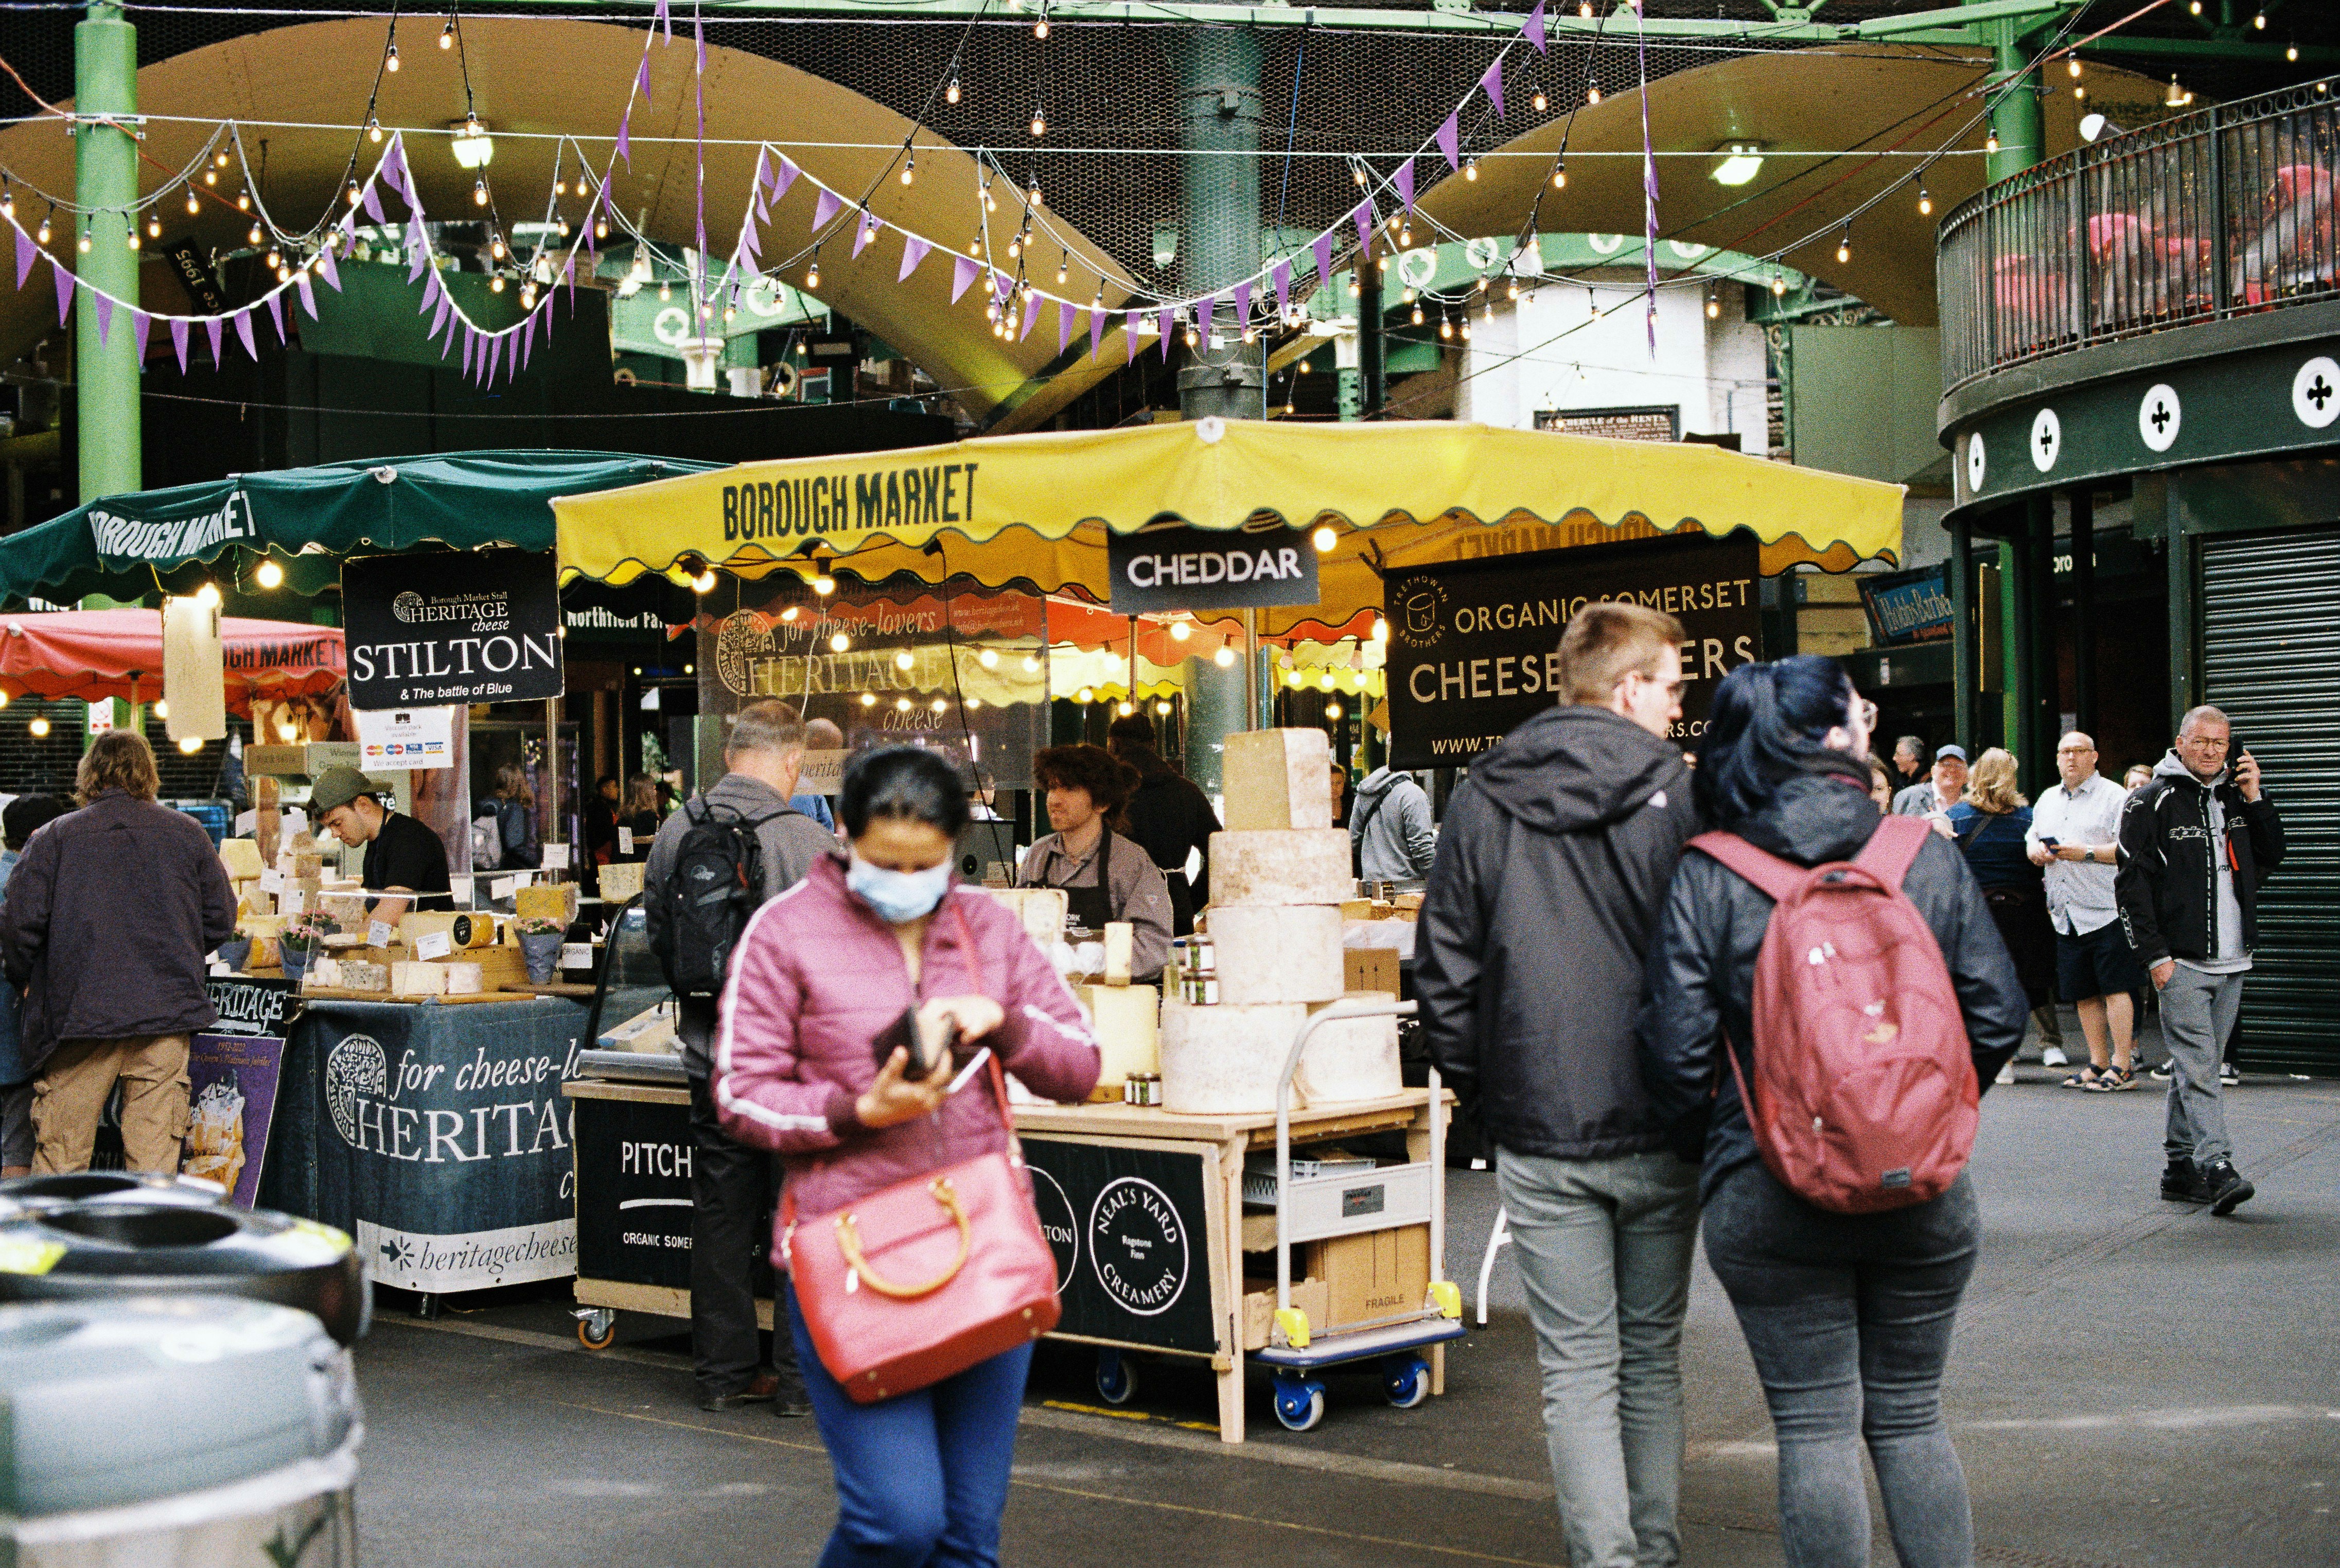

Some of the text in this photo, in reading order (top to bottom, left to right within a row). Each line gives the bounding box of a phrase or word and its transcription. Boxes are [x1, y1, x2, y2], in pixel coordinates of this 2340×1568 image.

[175, 249, 205, 287] 1995
[723, 463, 978, 540] BOROUGH MARKET
[1128, 549, 1302, 588] CHEDDAR
[431, 591, 507, 604] Borough Market Stall
[1393, 575, 1447, 605] TRETHOWAN
[1455, 579, 1751, 633] ORGANIC SOMERSET
[410, 602, 508, 623] HERITAGE
[472, 618, 509, 632] cheese
[780, 604, 936, 653] for cheese-lovers
[260, 639, 338, 667] MARKET
[1399, 624, 1446, 648] BROTHERS
[353, 632, 556, 681] STILTON
[744, 649, 941, 696] HERITAGE
[401, 683, 512, 699] & The battle of Blue
[884, 706, 942, 731] cheese
[390, 1049, 445, 1100] for
[354, 1098, 577, 1163] HERITA
[1098, 1187, 1177, 1245] NEAL'S YARD
[623, 1232, 660, 1246] ORGANIC
[1103, 1262, 1177, 1307] CREAMERY
[1366, 1293, 1404, 1310] FRAGILE
